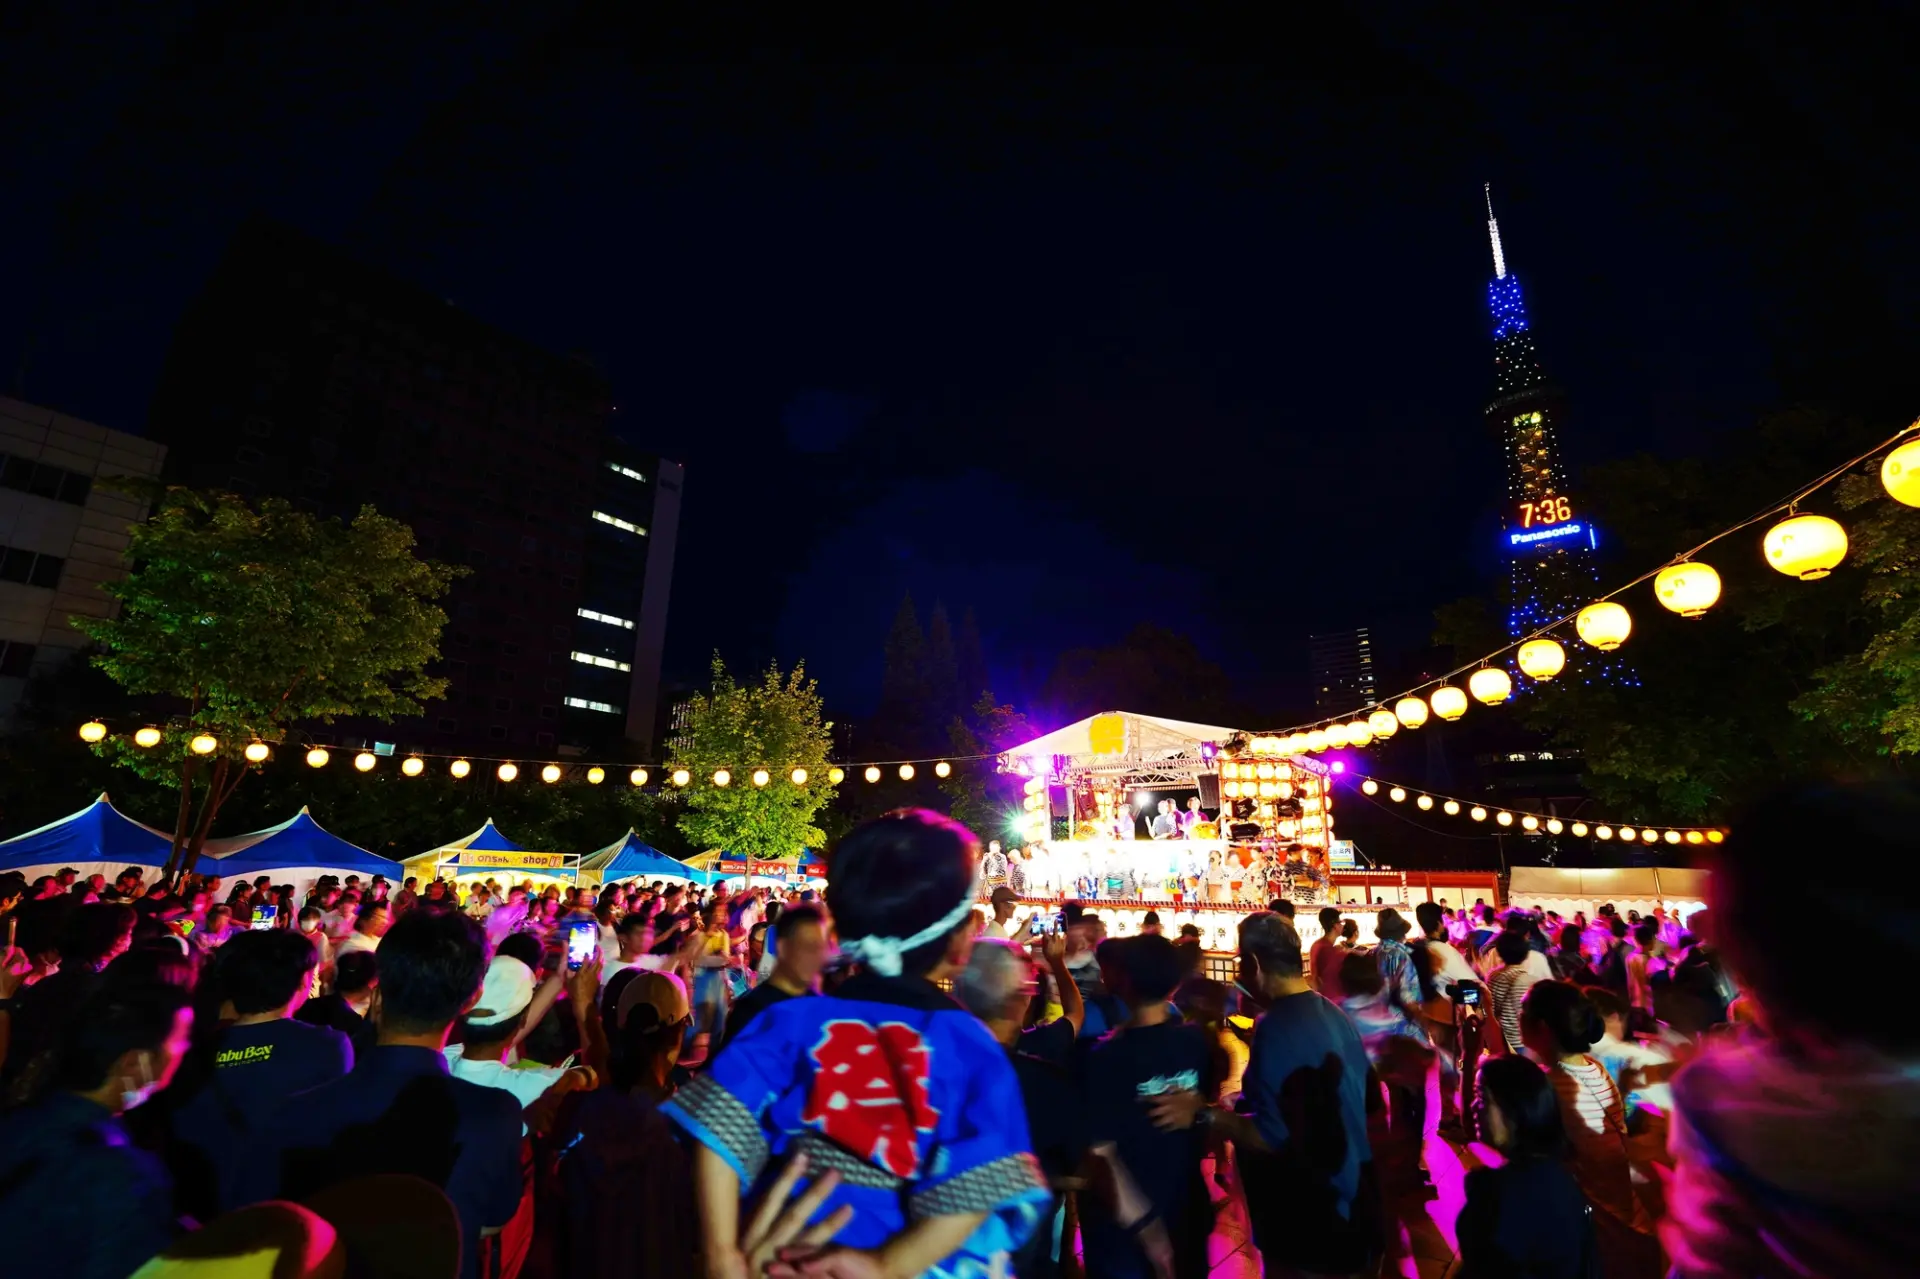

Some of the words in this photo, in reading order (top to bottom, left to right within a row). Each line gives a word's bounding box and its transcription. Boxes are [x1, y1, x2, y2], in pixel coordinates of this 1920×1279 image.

[1519, 496, 1571, 528] 7:36
[1511, 524, 1581, 544] Panasonic
[523, 856, 548, 866] shop
